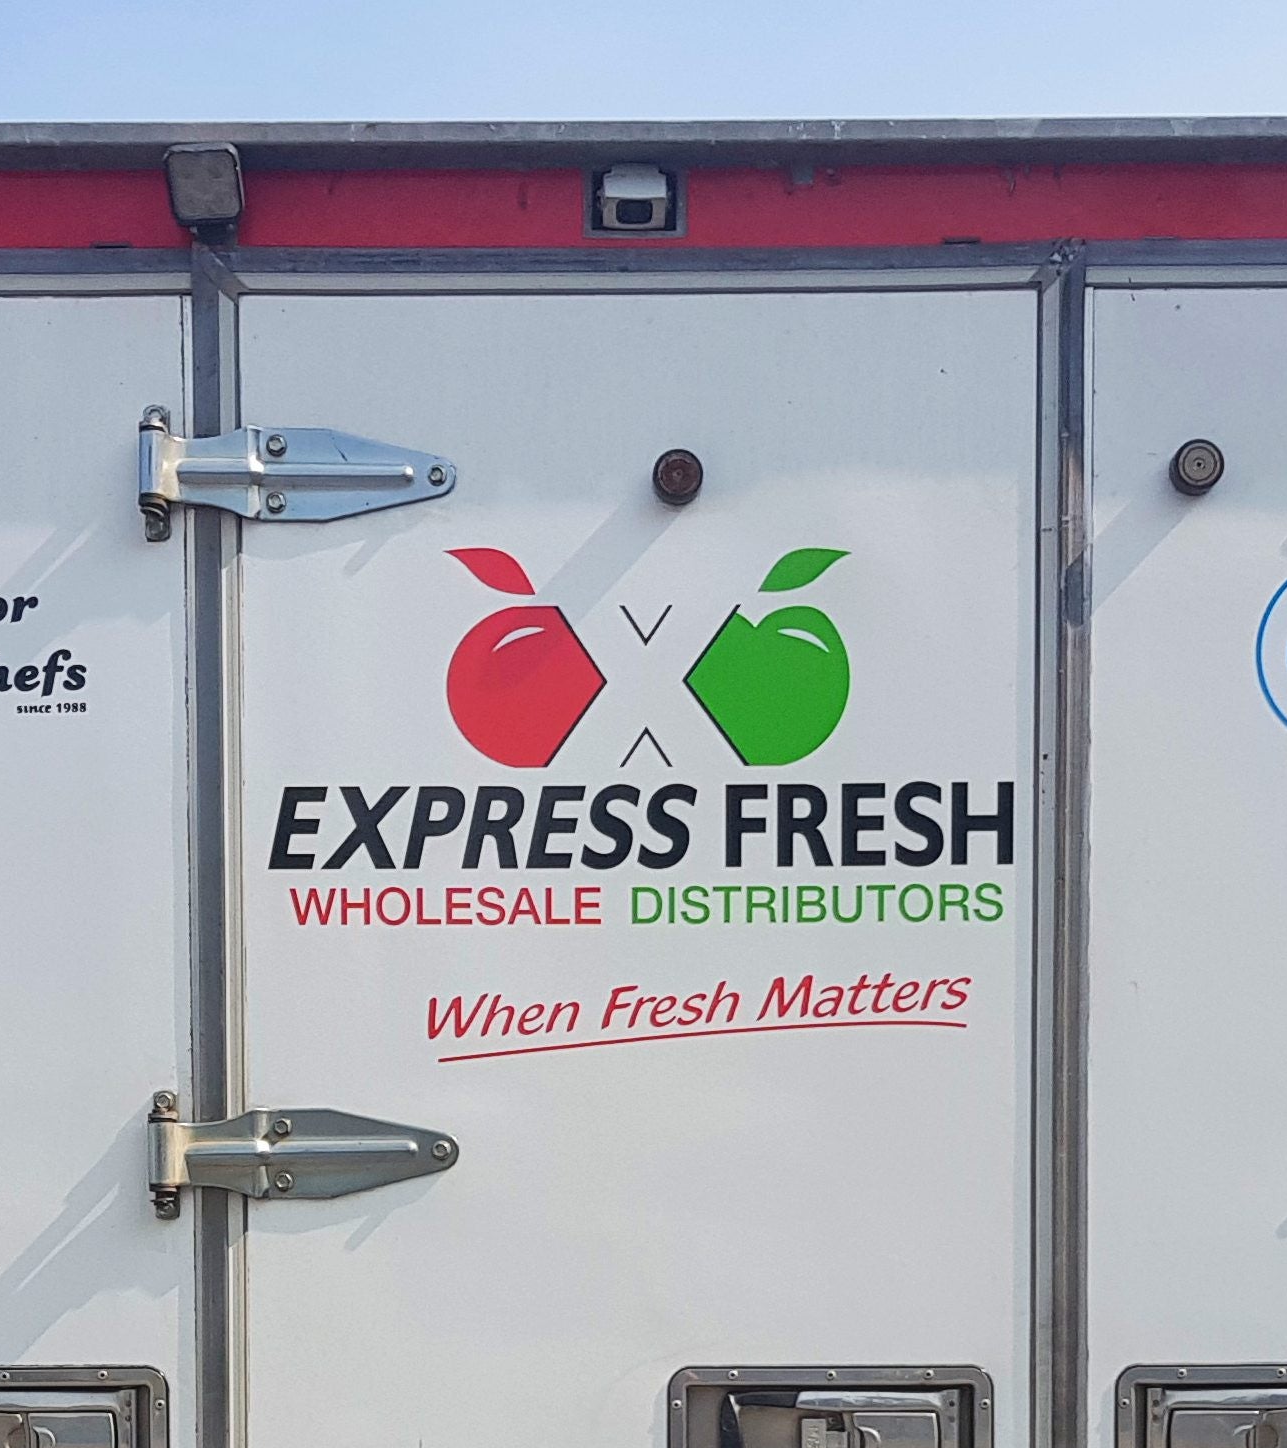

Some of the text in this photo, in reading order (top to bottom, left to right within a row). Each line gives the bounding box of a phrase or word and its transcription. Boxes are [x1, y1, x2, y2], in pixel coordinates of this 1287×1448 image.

[16, 702, 87, 714] since 1988
[268, 780, 1015, 870] EXPRESS FRESH
[290, 883, 1005, 926] WHOLESALE DISTRIBUTORS
[425, 972, 974, 1040] When Fresh Matters
